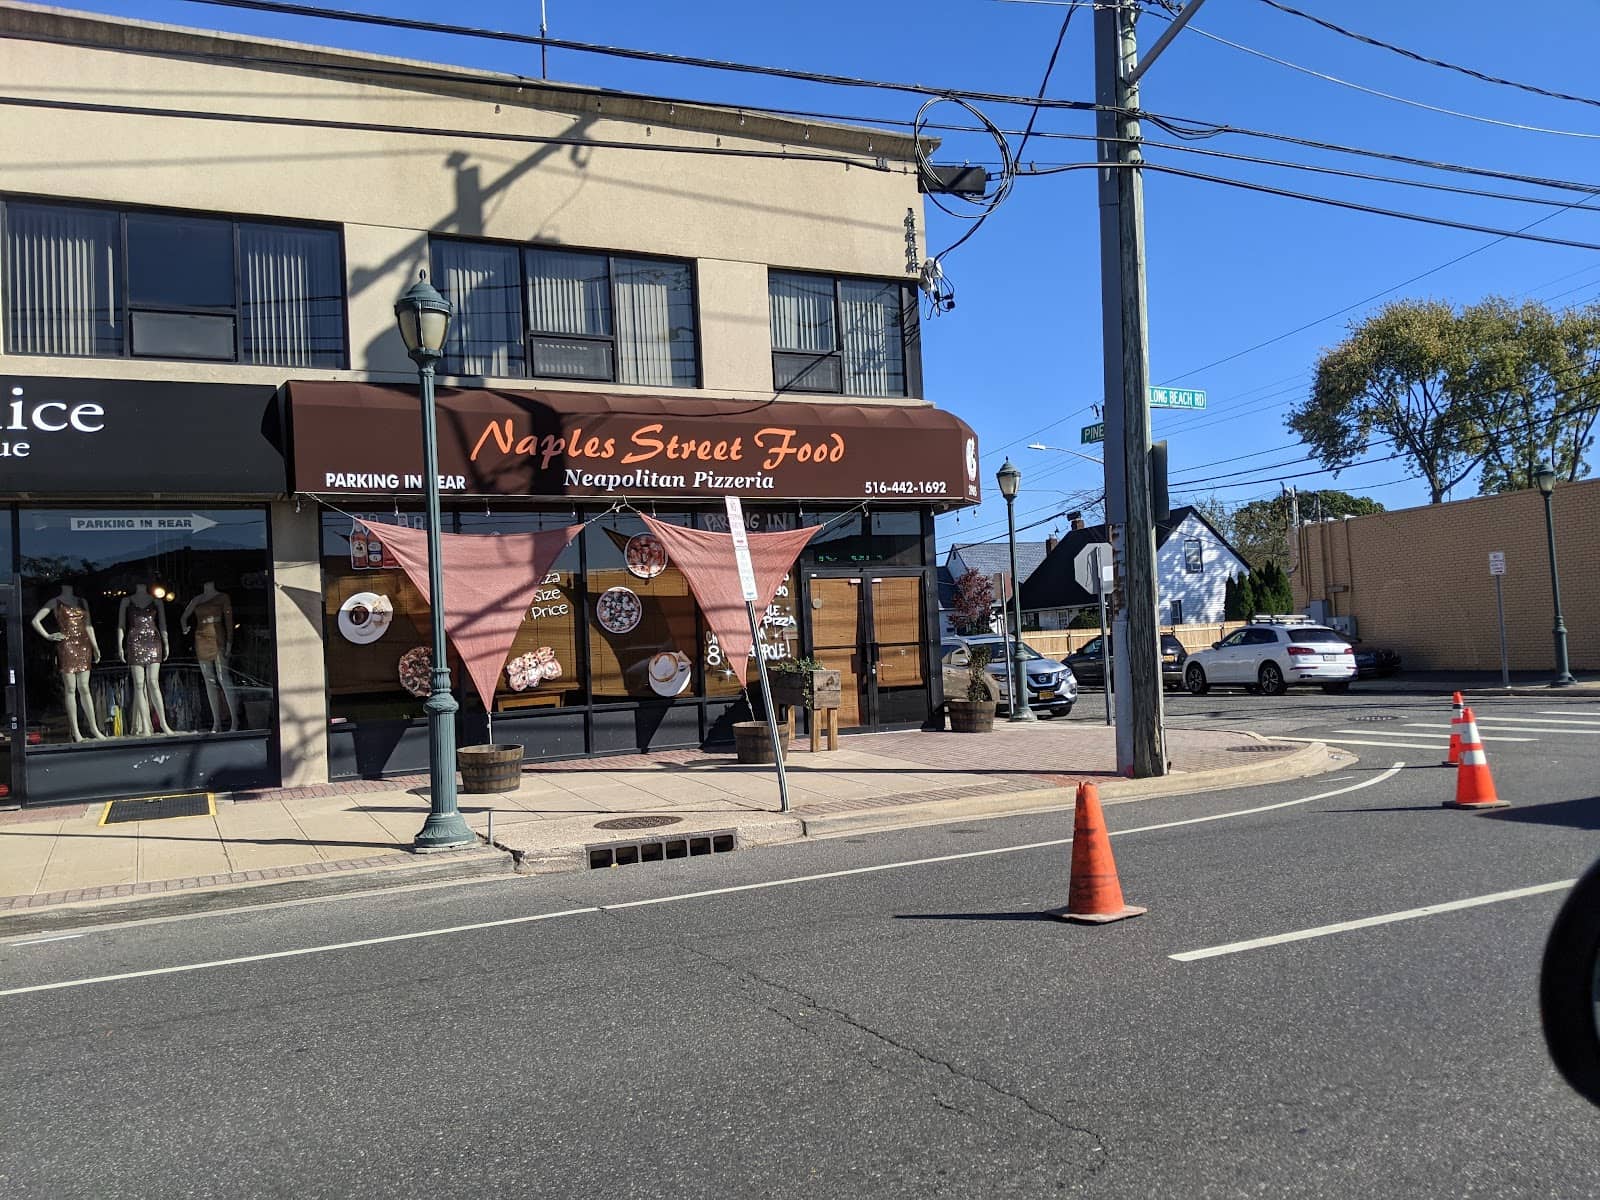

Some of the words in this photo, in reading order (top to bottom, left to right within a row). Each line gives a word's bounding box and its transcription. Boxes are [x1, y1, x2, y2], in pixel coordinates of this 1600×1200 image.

[1150, 388, 1168, 403] LONG
[1169, 389, 1193, 405] BEACH
[1195, 392, 1205, 407] RD
[0, 387, 105, 433] ice
[1084, 424, 1105, 441] PINE
[470, 418, 616, 470] Naples
[620, 423, 744, 464] Street
[753, 427, 846, 470] Food
[325, 472, 400, 489] PARKING
[404, 474, 423, 489] IN
[437, 475, 466, 489] EAR
[563, 468, 686, 492] Neapolitan
[692, 471, 775, 490] Pizzeria
[865, 481, 947, 494] 516-442-1692
[77, 519, 135, 529] PARKING
[140, 519, 153, 528] IN
[158, 518, 192, 528] REAR
[767, 513, 787, 530] IN
[531, 604, 569, 619] Price
[763, 615, 796, 629] PIZZA
